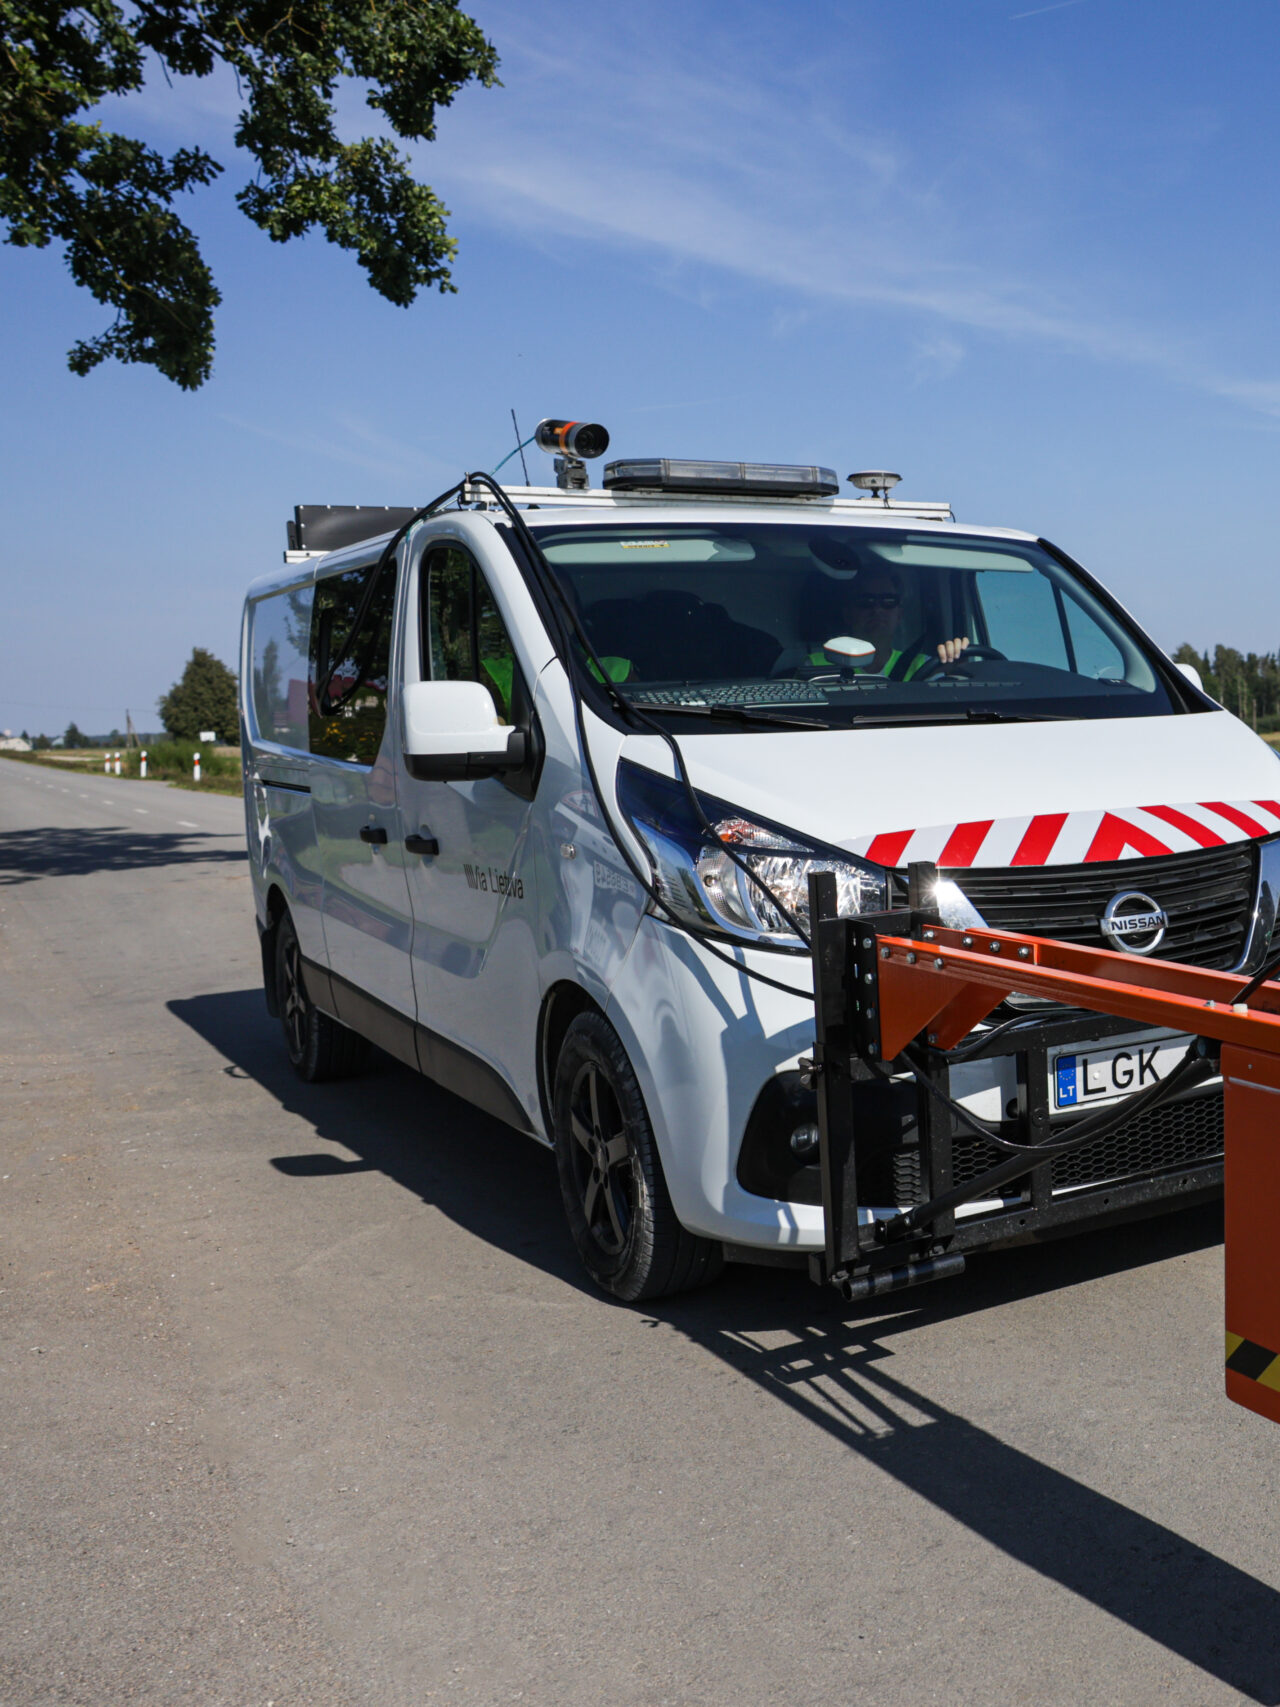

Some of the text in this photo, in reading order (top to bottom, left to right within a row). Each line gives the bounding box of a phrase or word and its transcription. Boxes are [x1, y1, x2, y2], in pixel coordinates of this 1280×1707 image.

[464, 864, 488, 891] Via
[1110, 915, 1165, 931] NISSAN
[1059, 1085, 1075, 1098] LT
